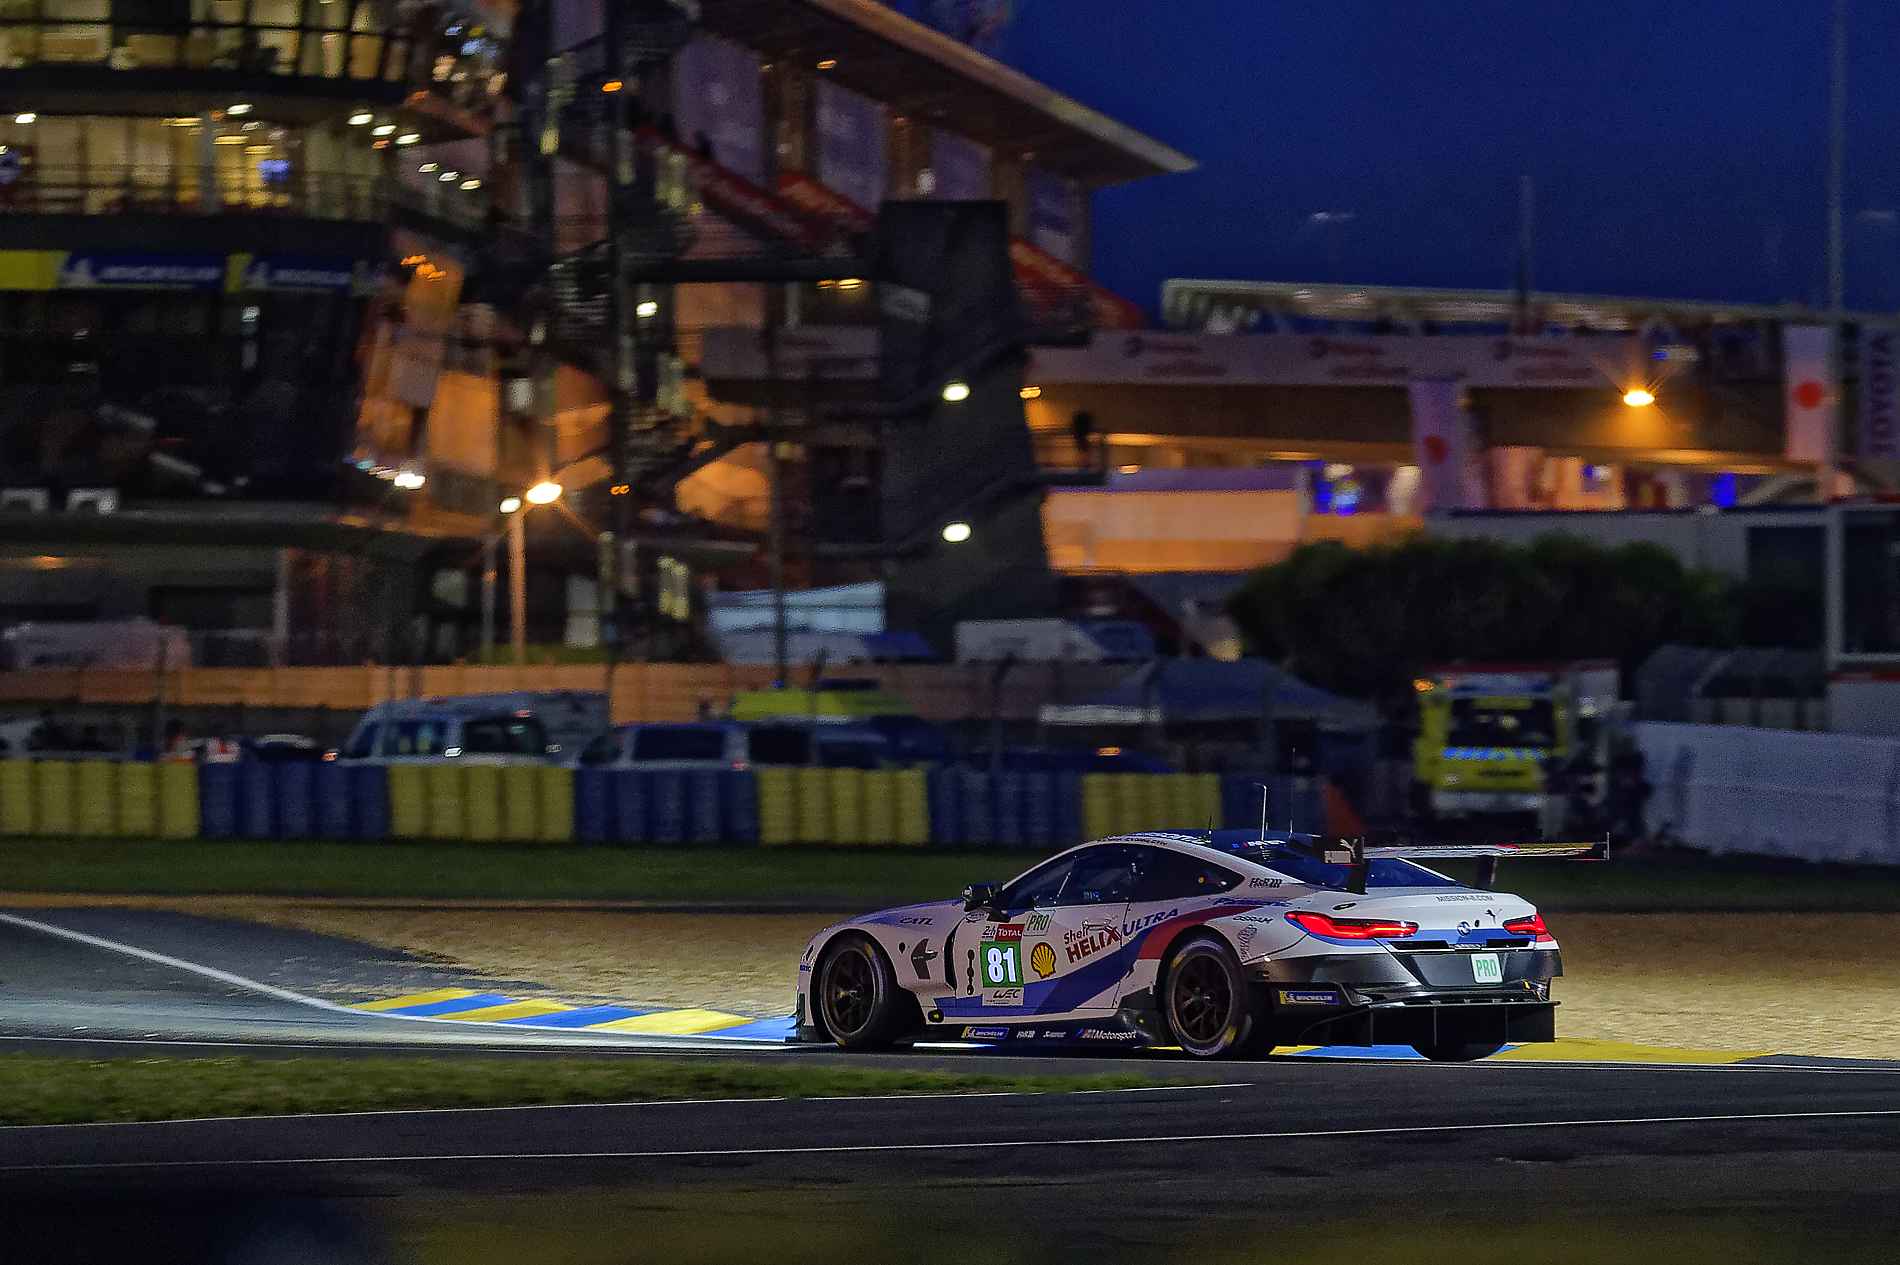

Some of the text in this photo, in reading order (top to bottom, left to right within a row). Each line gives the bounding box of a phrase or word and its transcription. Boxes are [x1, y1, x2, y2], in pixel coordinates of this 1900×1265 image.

[1026, 912, 1050, 932] PRO
[1122, 908, 1178, 937] ULTRA
[998, 928, 1022, 937] TOTAL
[1063, 924, 1090, 944] Shell
[1065, 926, 1122, 964] HELIX
[987, 947, 1017, 983] 81
[1475, 959, 1498, 977] PRO
[992, 988, 1021, 999] WEC
